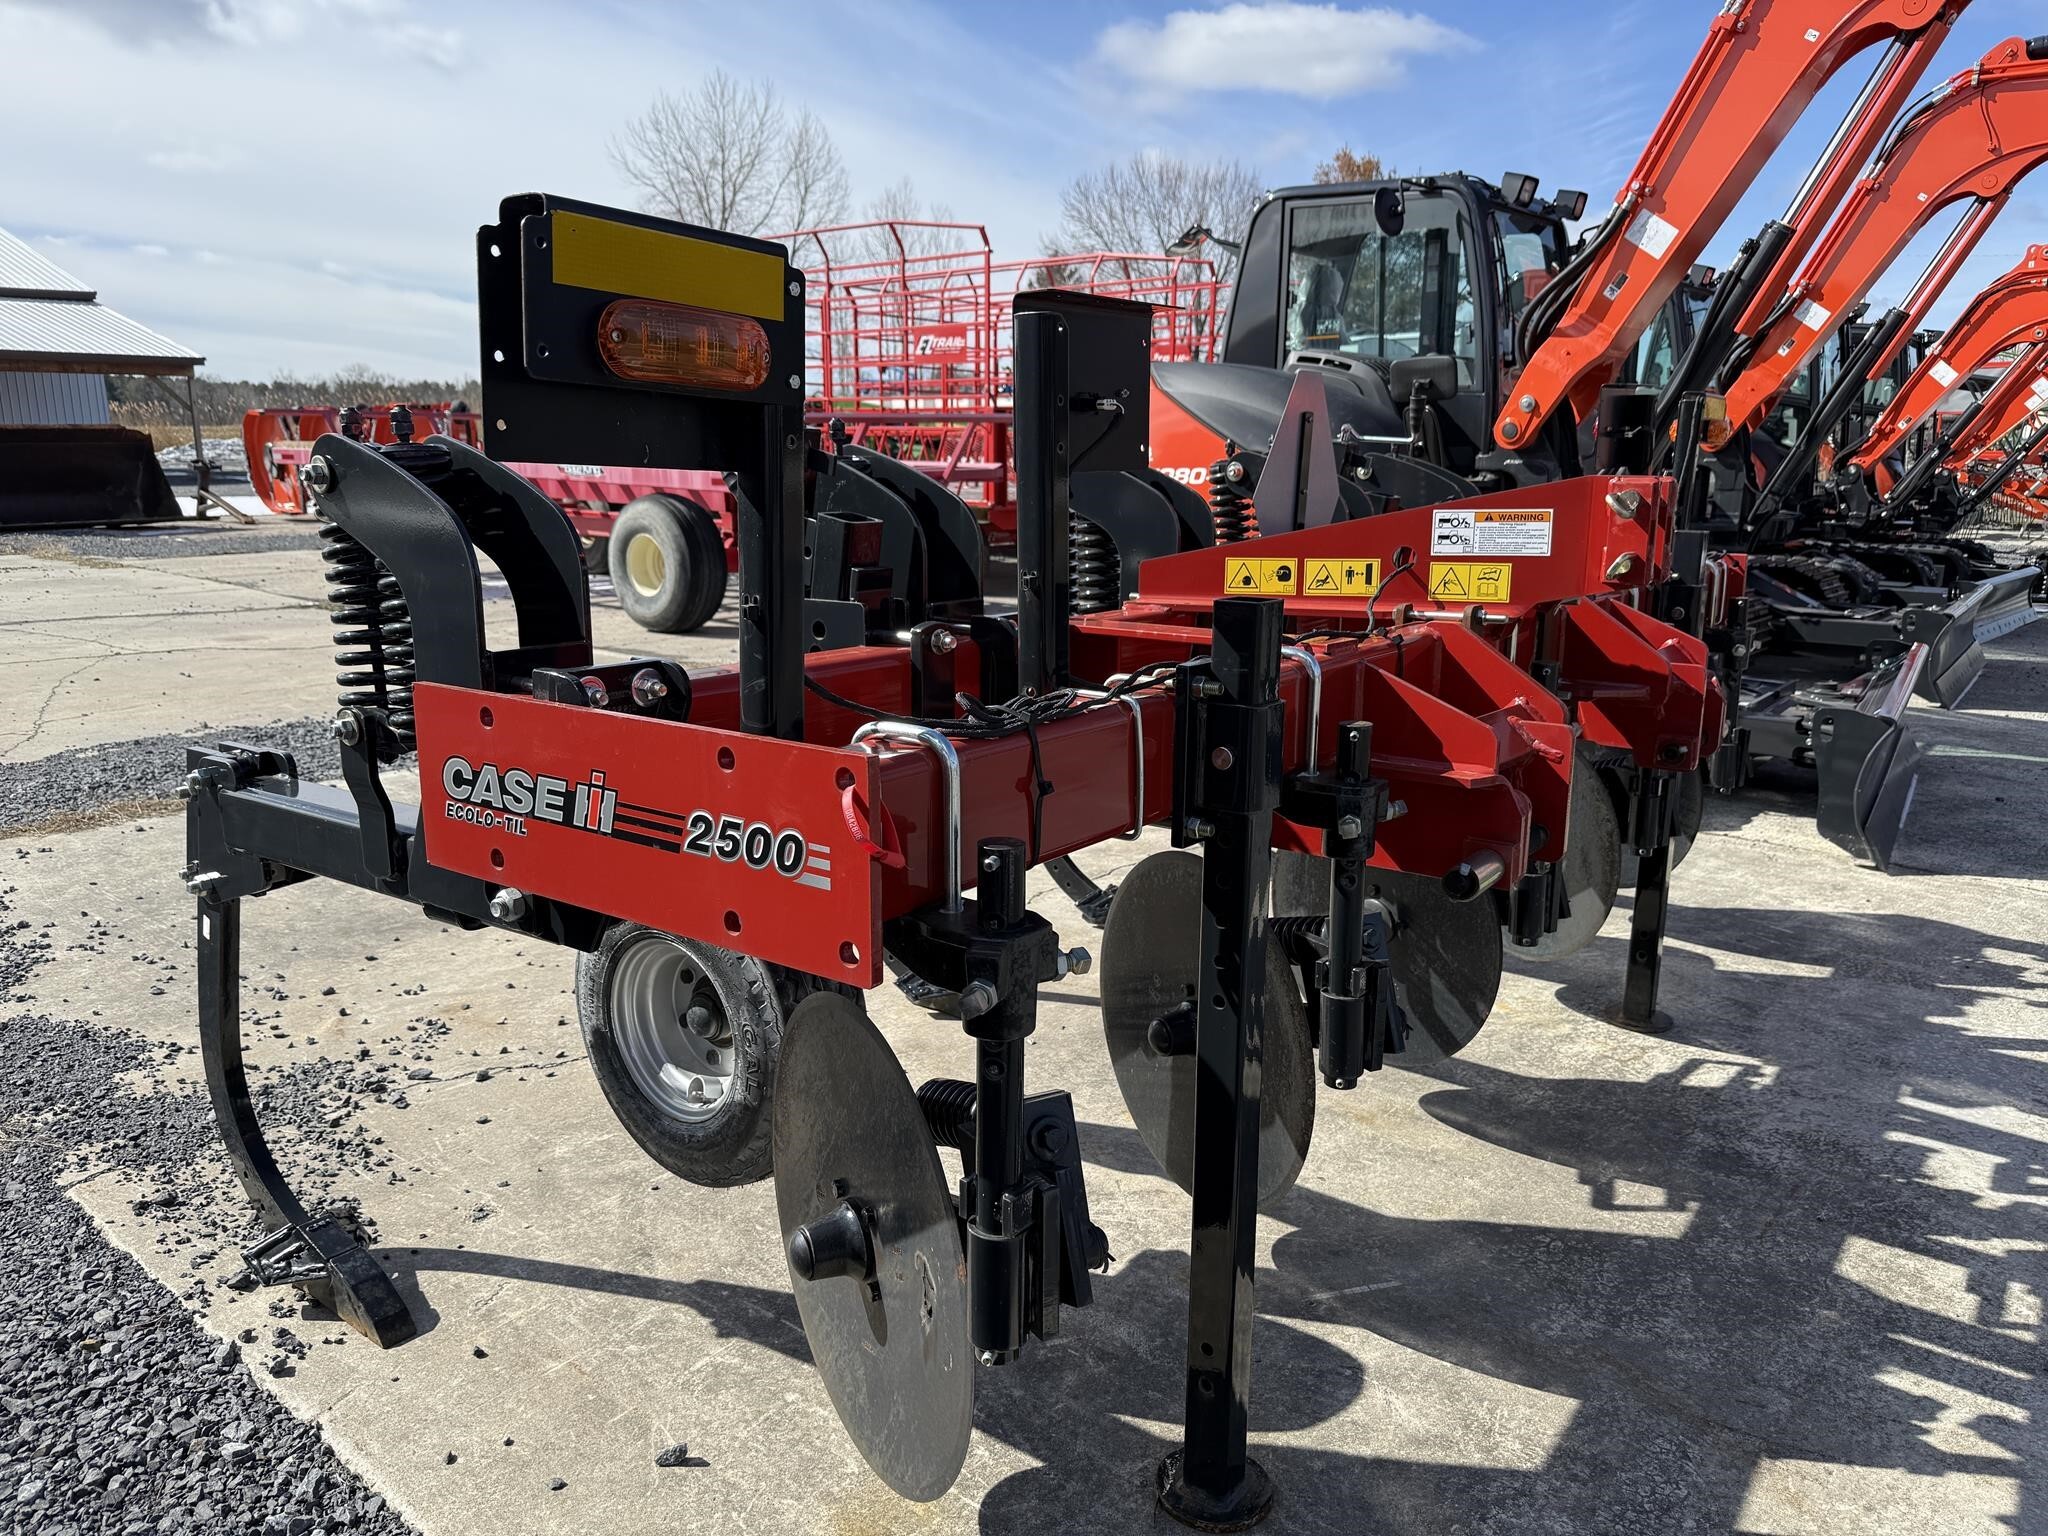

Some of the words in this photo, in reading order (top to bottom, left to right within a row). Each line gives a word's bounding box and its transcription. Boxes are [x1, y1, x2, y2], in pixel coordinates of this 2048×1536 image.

[442, 755, 567, 823] CASE
[445, 800, 528, 836] ECOLO-TIL
[683, 809, 807, 877] 2500
